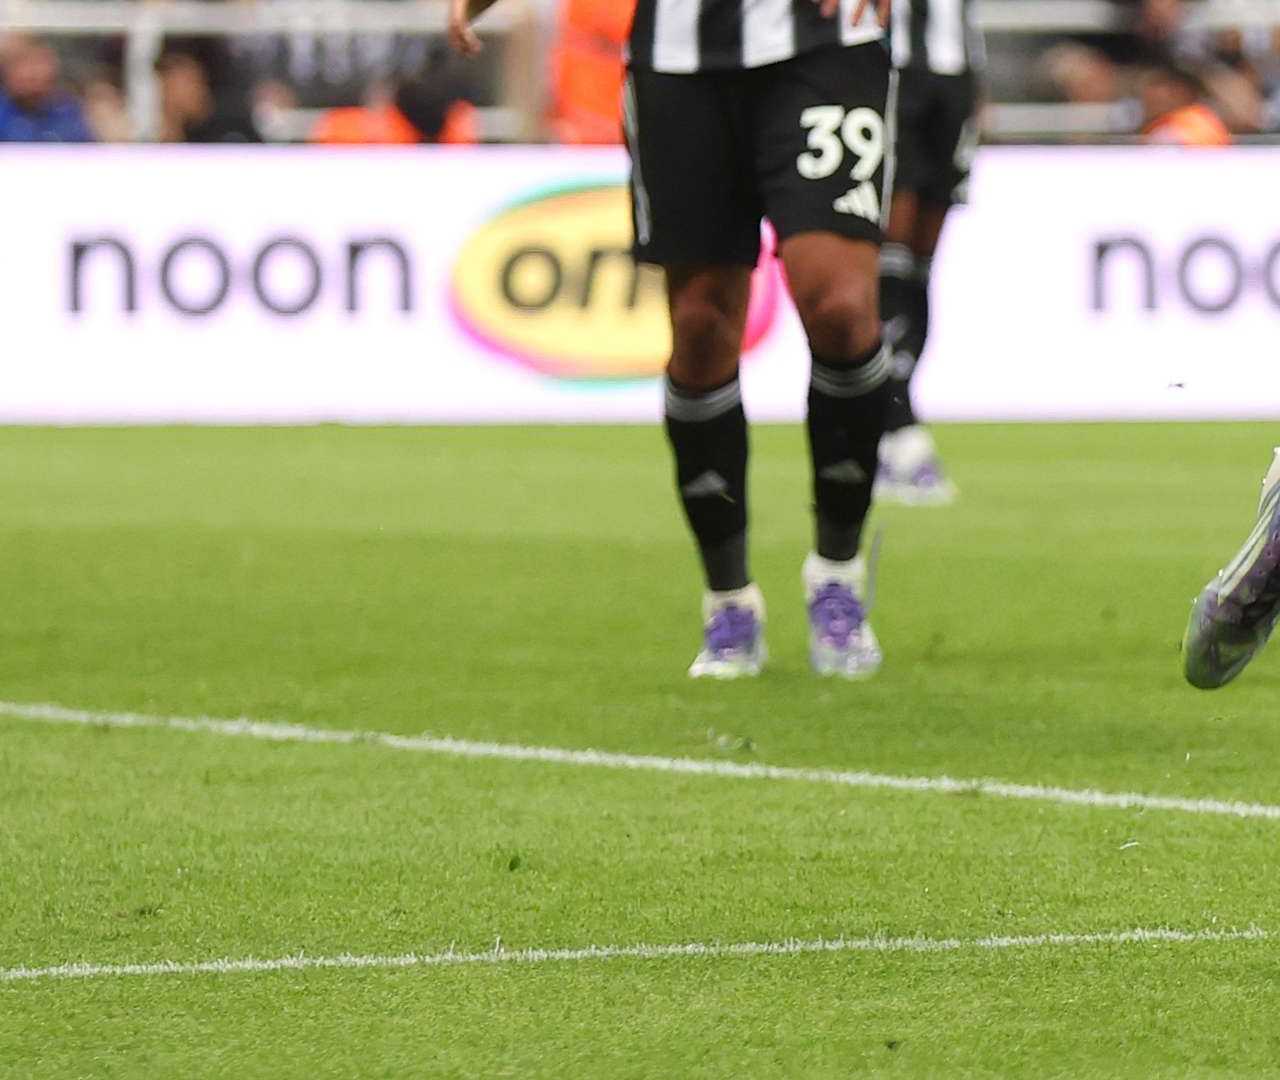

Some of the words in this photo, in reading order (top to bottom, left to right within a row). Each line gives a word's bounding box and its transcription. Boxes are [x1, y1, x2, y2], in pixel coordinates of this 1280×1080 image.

[797, 104, 885, 182] 39
[72, 238, 411, 315] noon
[501, 246, 640, 311] on
